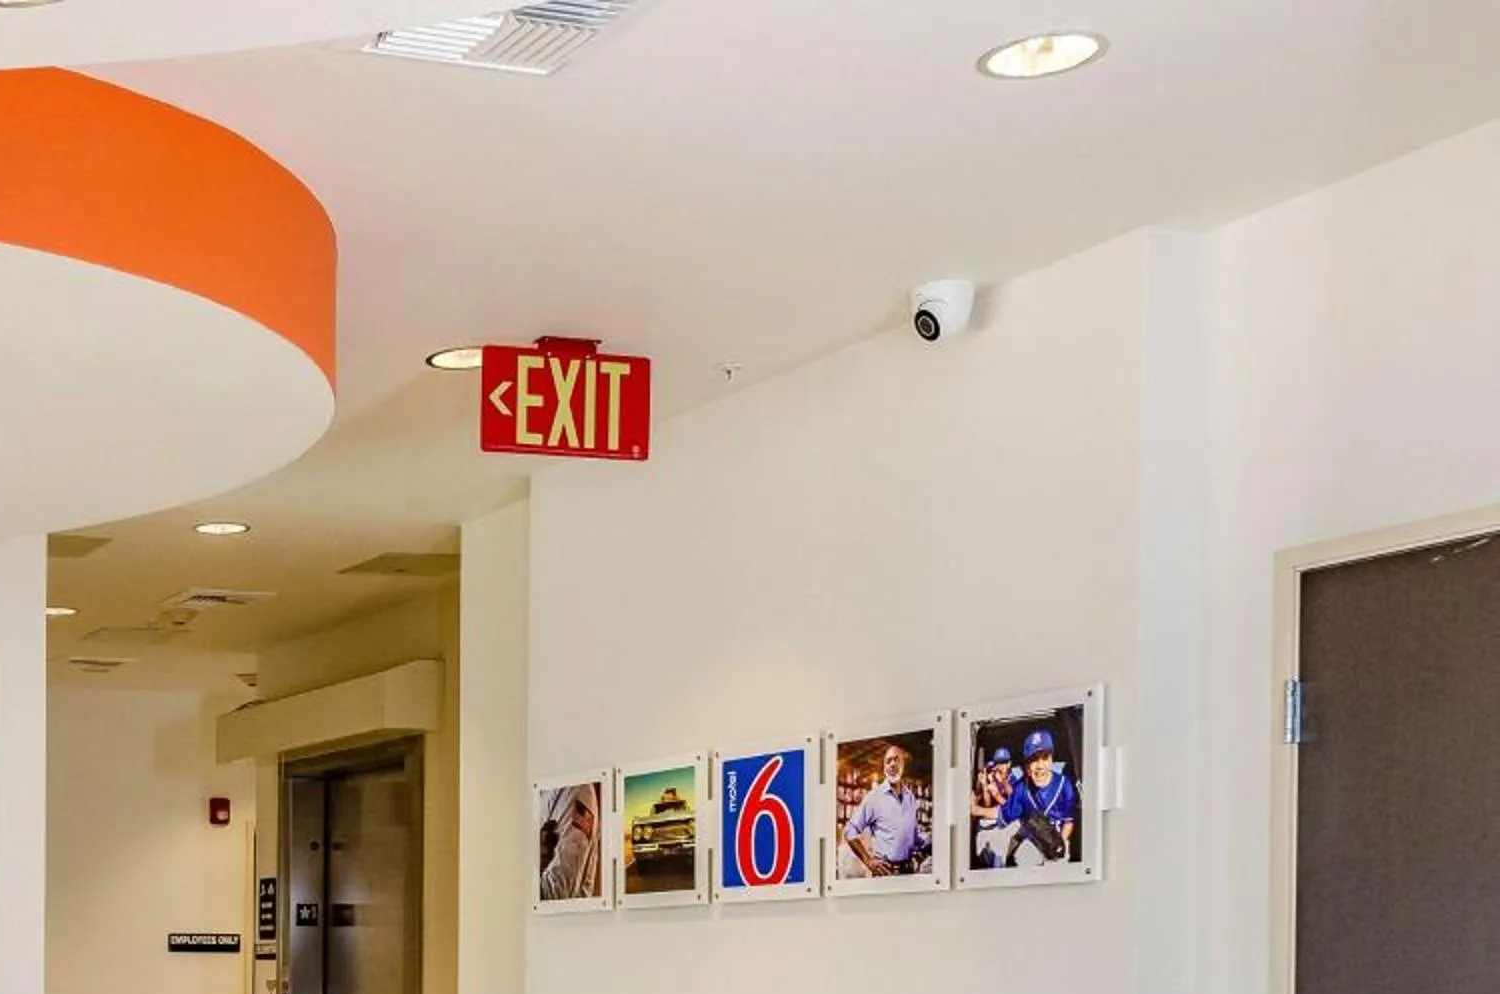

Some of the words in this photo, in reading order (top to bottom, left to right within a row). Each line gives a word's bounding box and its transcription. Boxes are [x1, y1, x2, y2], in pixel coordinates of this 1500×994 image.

[516, 355, 630, 450] EXIT
[727, 771, 736, 812] motel
[736, 756, 795, 887] 6
[170, 935, 217, 945] EMPLOYEES
[217, 935, 239, 945] ONLY
